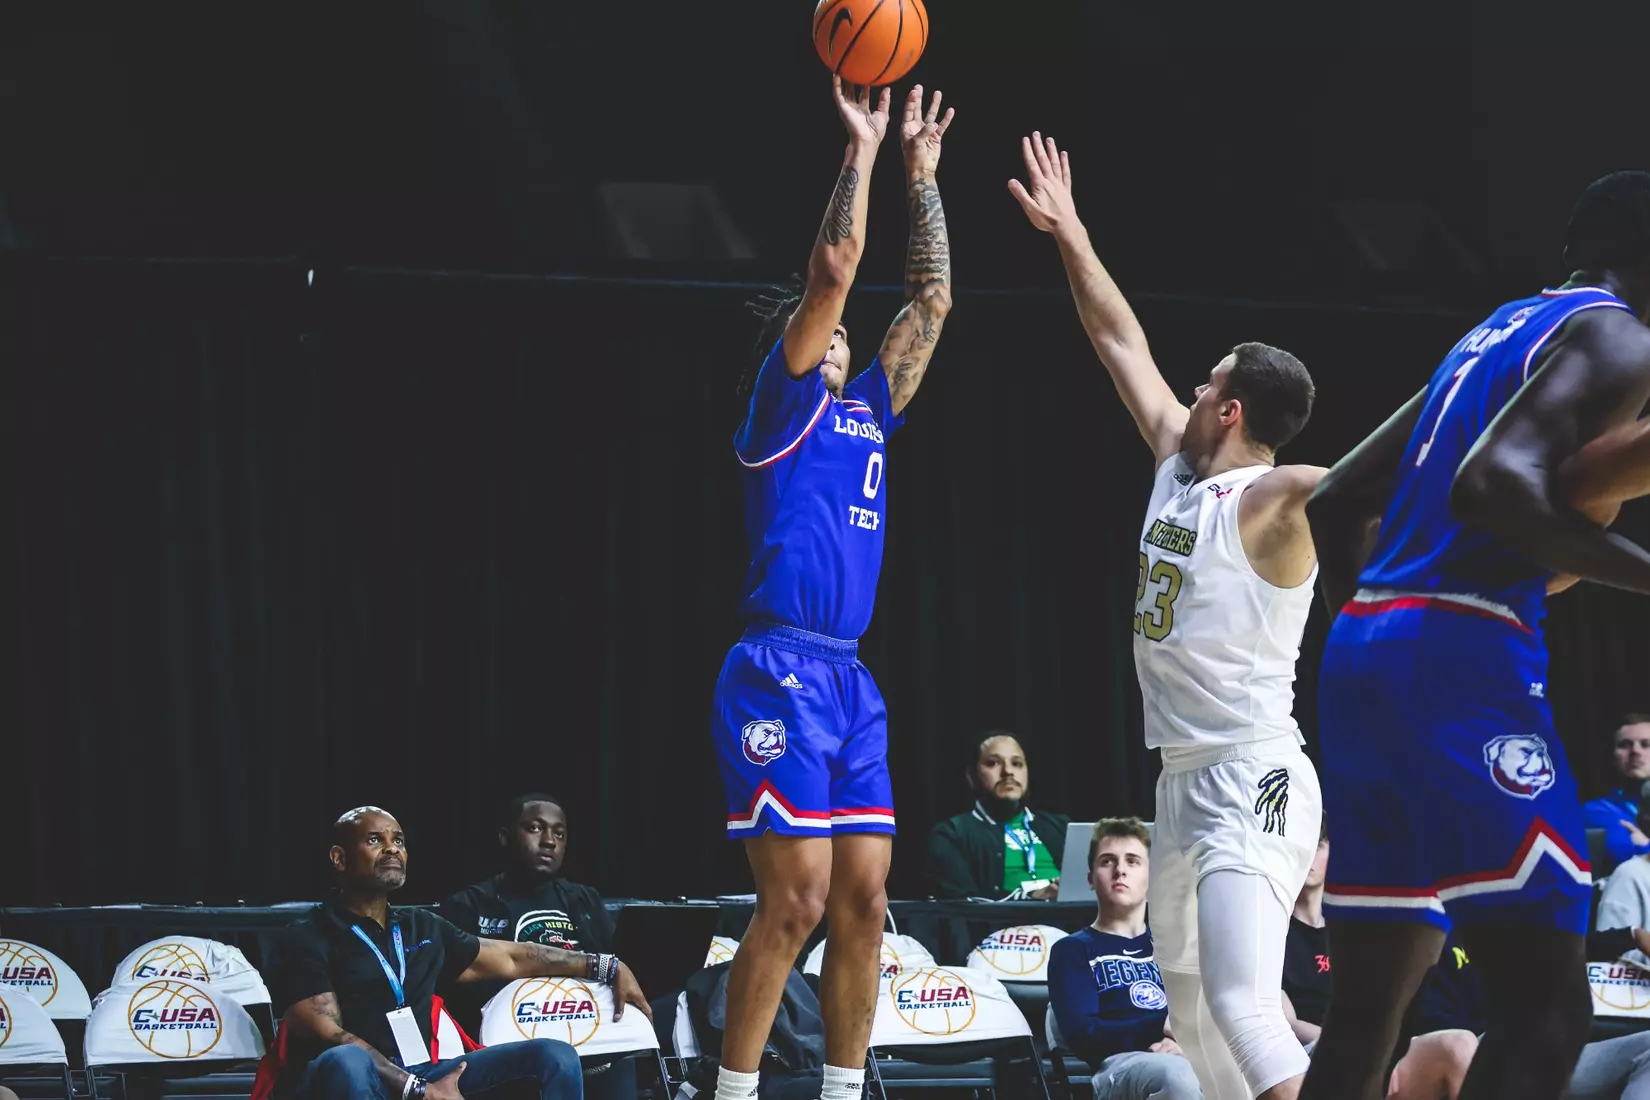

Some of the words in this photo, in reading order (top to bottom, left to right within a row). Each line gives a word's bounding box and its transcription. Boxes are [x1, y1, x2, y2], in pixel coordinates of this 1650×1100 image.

[863, 451, 884, 500] 0
[1133, 551, 1183, 643] 23
[999, 934, 1042, 946] USA
[2, 967, 53, 980] USA
[1608, 967, 1637, 980] US
[919, 986, 970, 1003] USA
[541, 1000, 594, 1015] USA
[898, 1000, 972, 1011] BASKETBALL
[159, 1007, 217, 1023] USA
[517, 1013, 596, 1024] BASKETBALL
[133, 1022, 218, 1031] BASKETBALL
